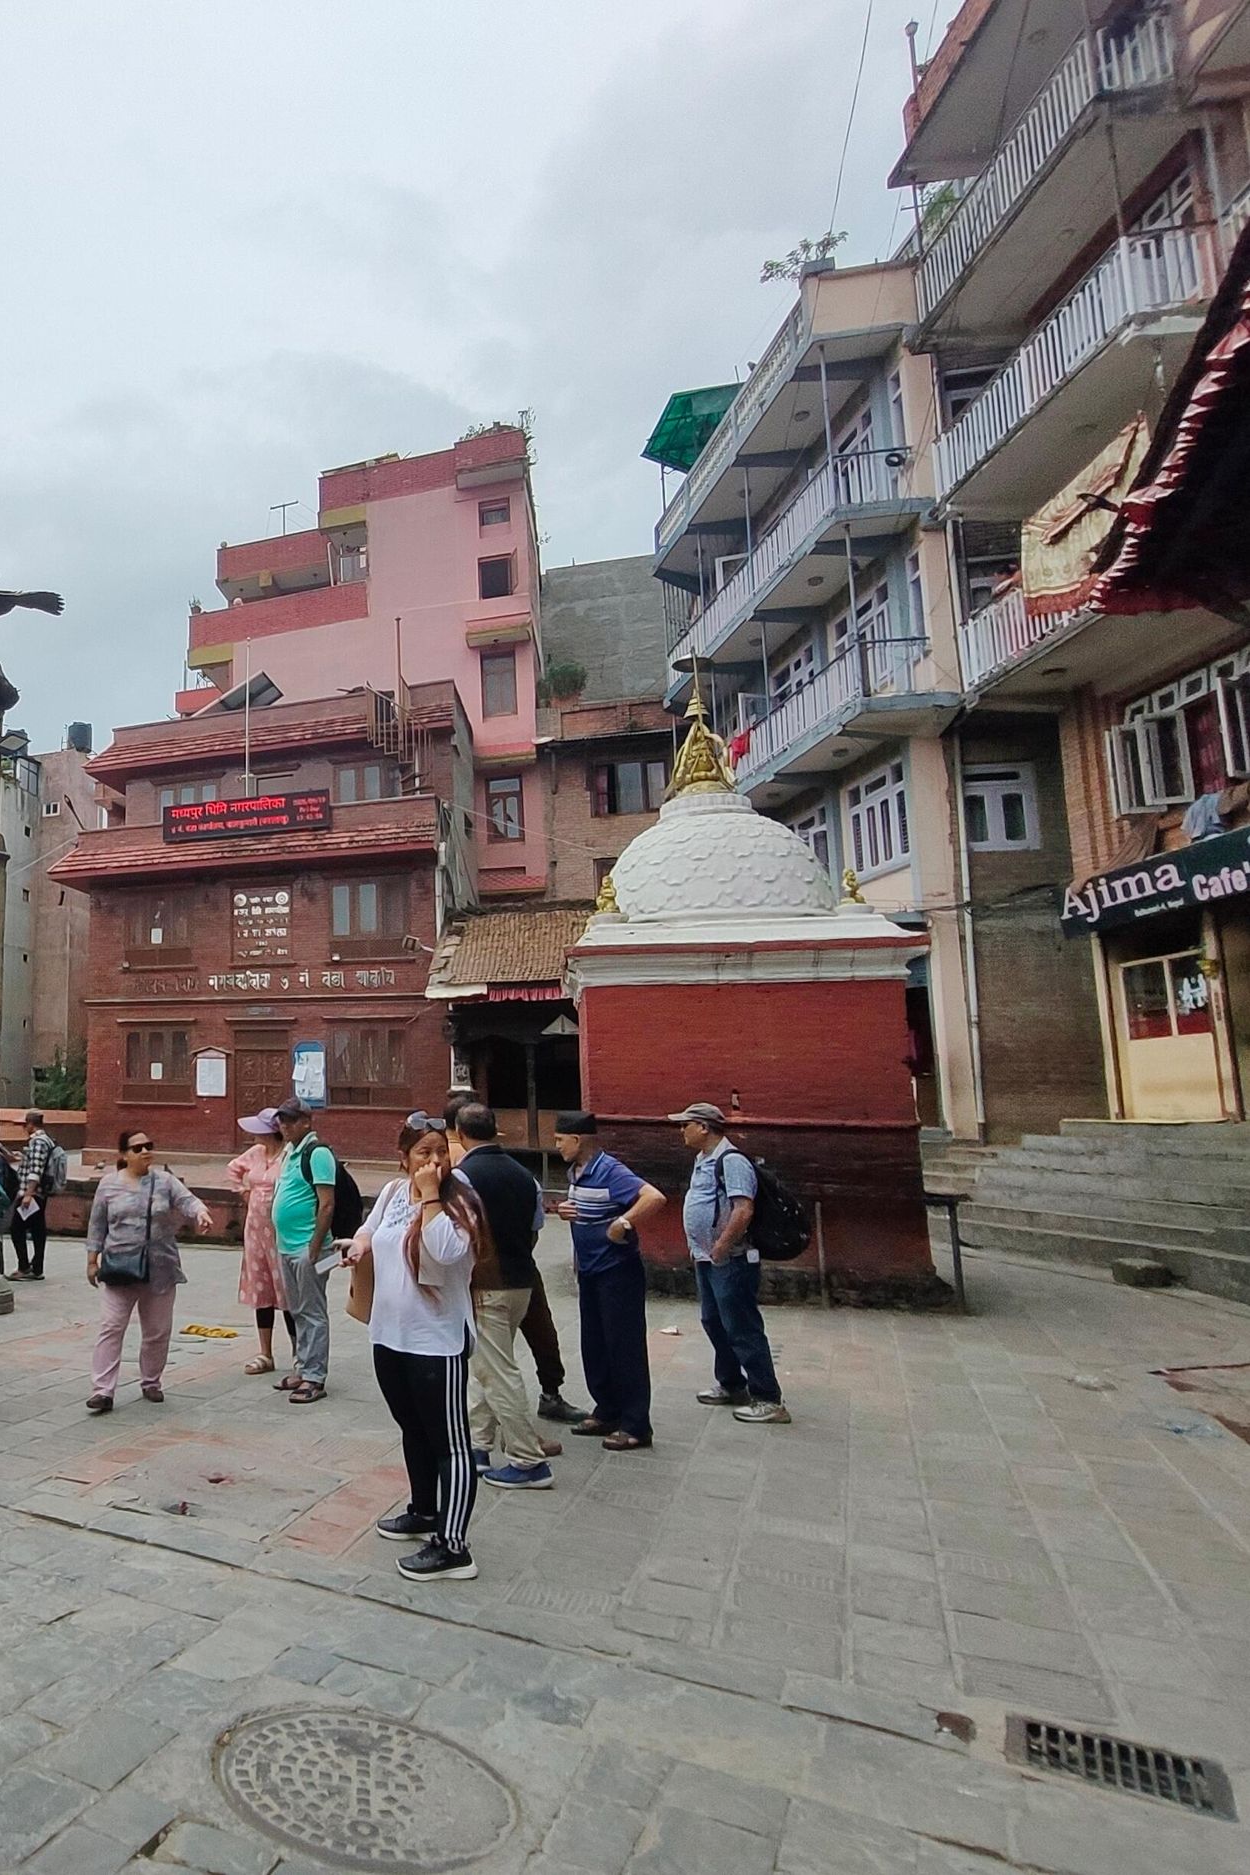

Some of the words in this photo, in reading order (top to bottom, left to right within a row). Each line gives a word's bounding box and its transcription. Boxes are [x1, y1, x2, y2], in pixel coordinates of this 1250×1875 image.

[171, 806, 204, 820] मध्यपुर
[205, 801, 228, 816] थिमि
[230, 797, 286, 812] नगरपालिका
[1060, 862, 1187, 923] Ajima
